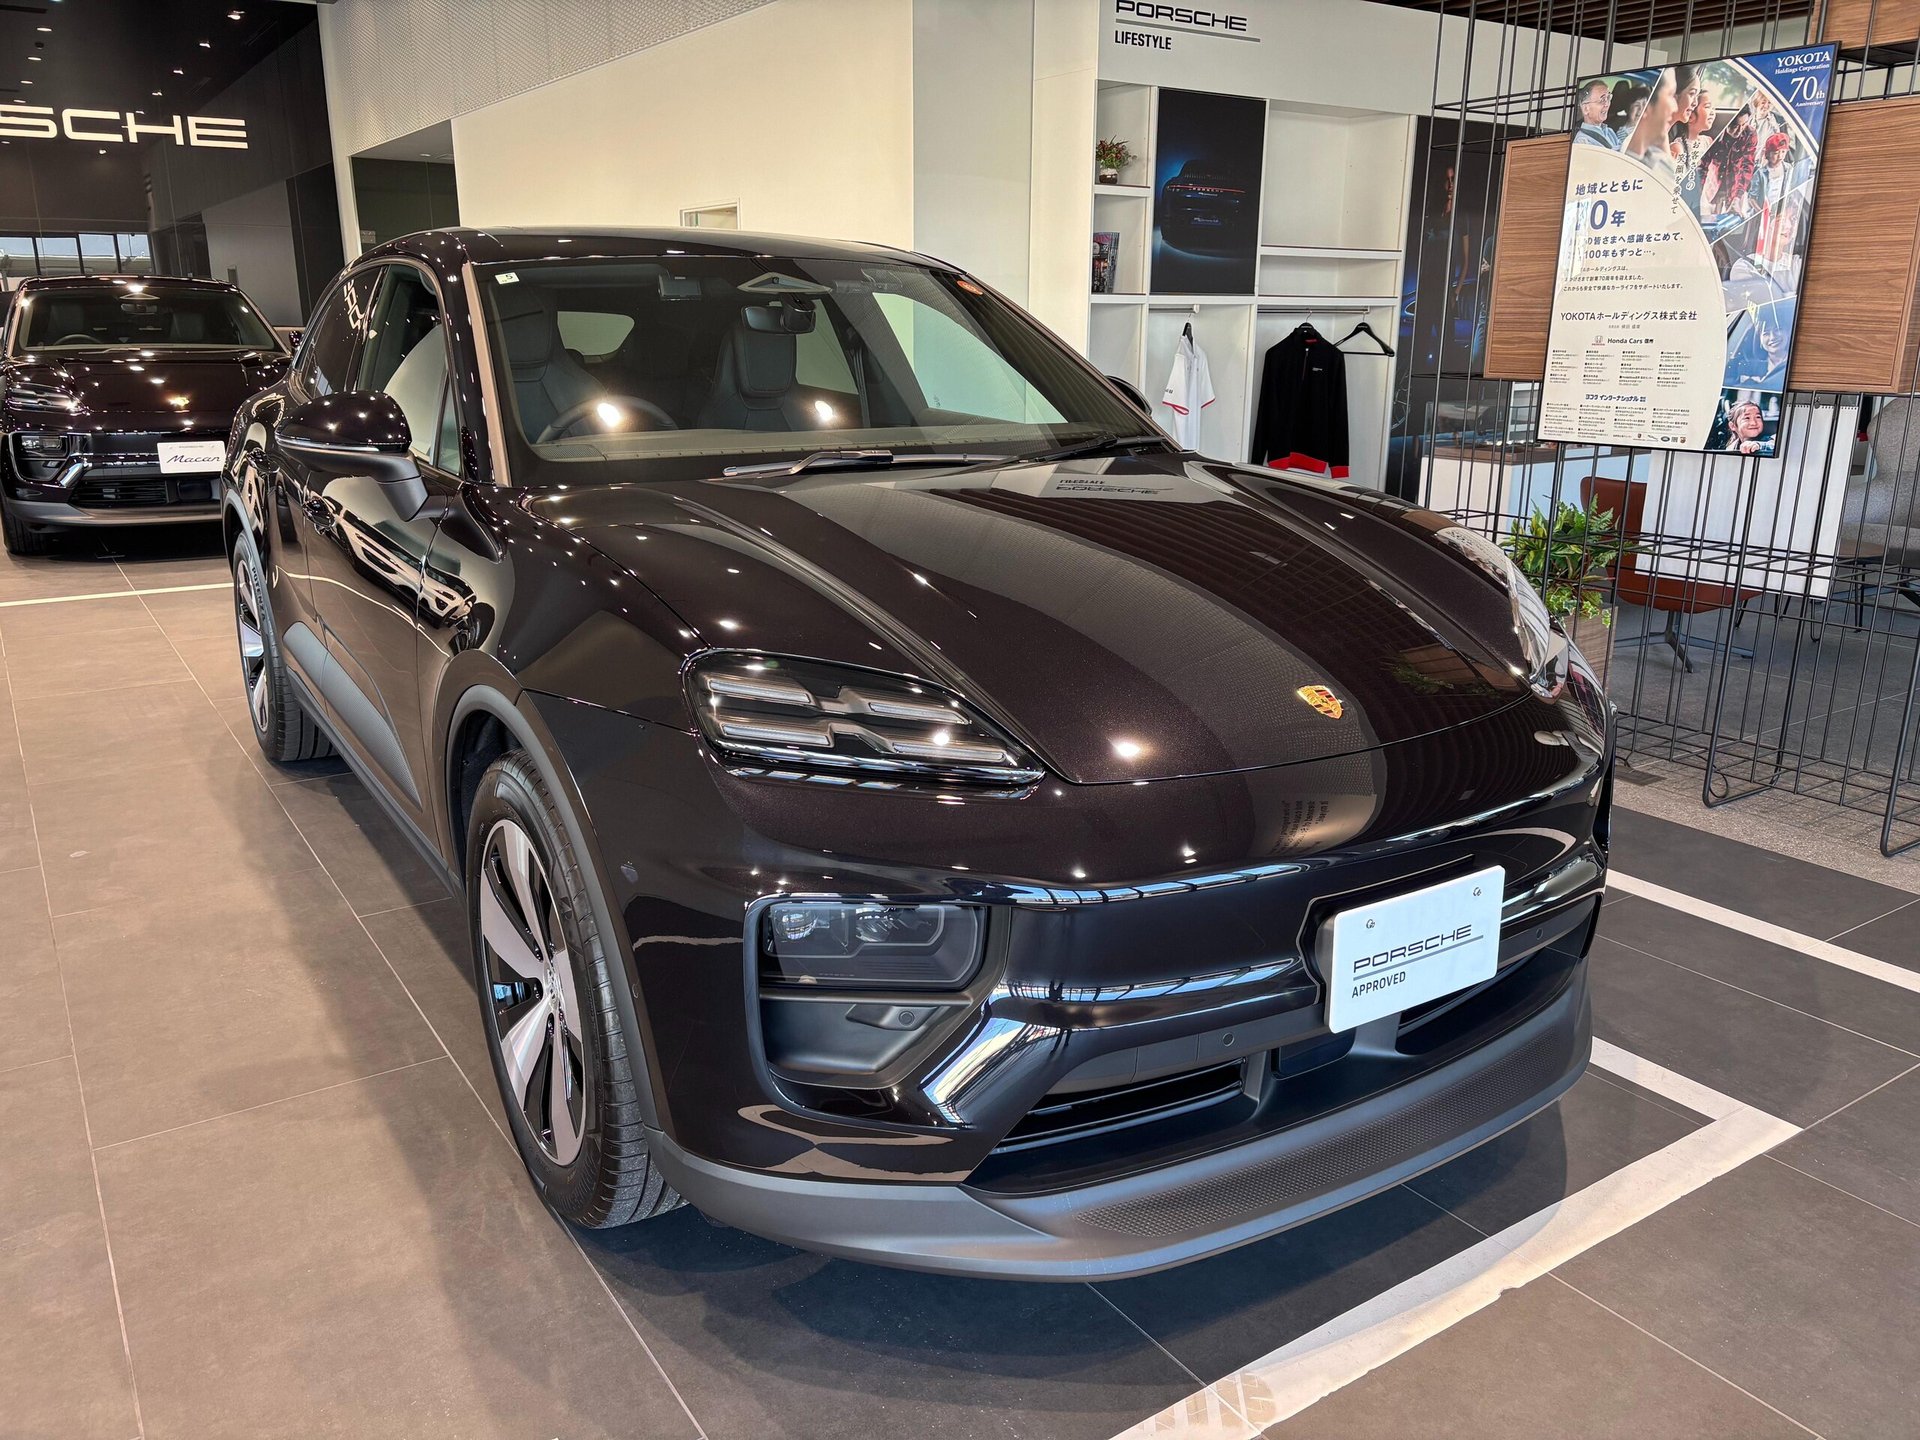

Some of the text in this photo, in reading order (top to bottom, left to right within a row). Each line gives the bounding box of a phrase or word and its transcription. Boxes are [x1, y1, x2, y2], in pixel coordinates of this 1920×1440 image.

[1115, 0, 1248, 31] PORSCHE
[1114, 30, 1172, 50] LIFESTYLE
[1777, 51, 1831, 68] YOKOTA
[1798, 63, 1830, 72] Corporation
[1686, 141, 1701, 191] お客さまの
[1575, 179, 1644, 196] 地域とともに
[1670, 153, 1687, 215] 笑顔を乗せて
[1589, 199, 1626, 230] 0年
[1585, 232, 1684, 246] の皆さまへ感謝をこめて、
[1560, 310, 1698, 321] YOKOTAホールディングス株式会社
[166, 454, 221, 464] Macan
[251, 566, 267, 622] POTENZA
[1353, 924, 1472, 974] PORSCHE
[1351, 971, 1406, 999] APPROVED
